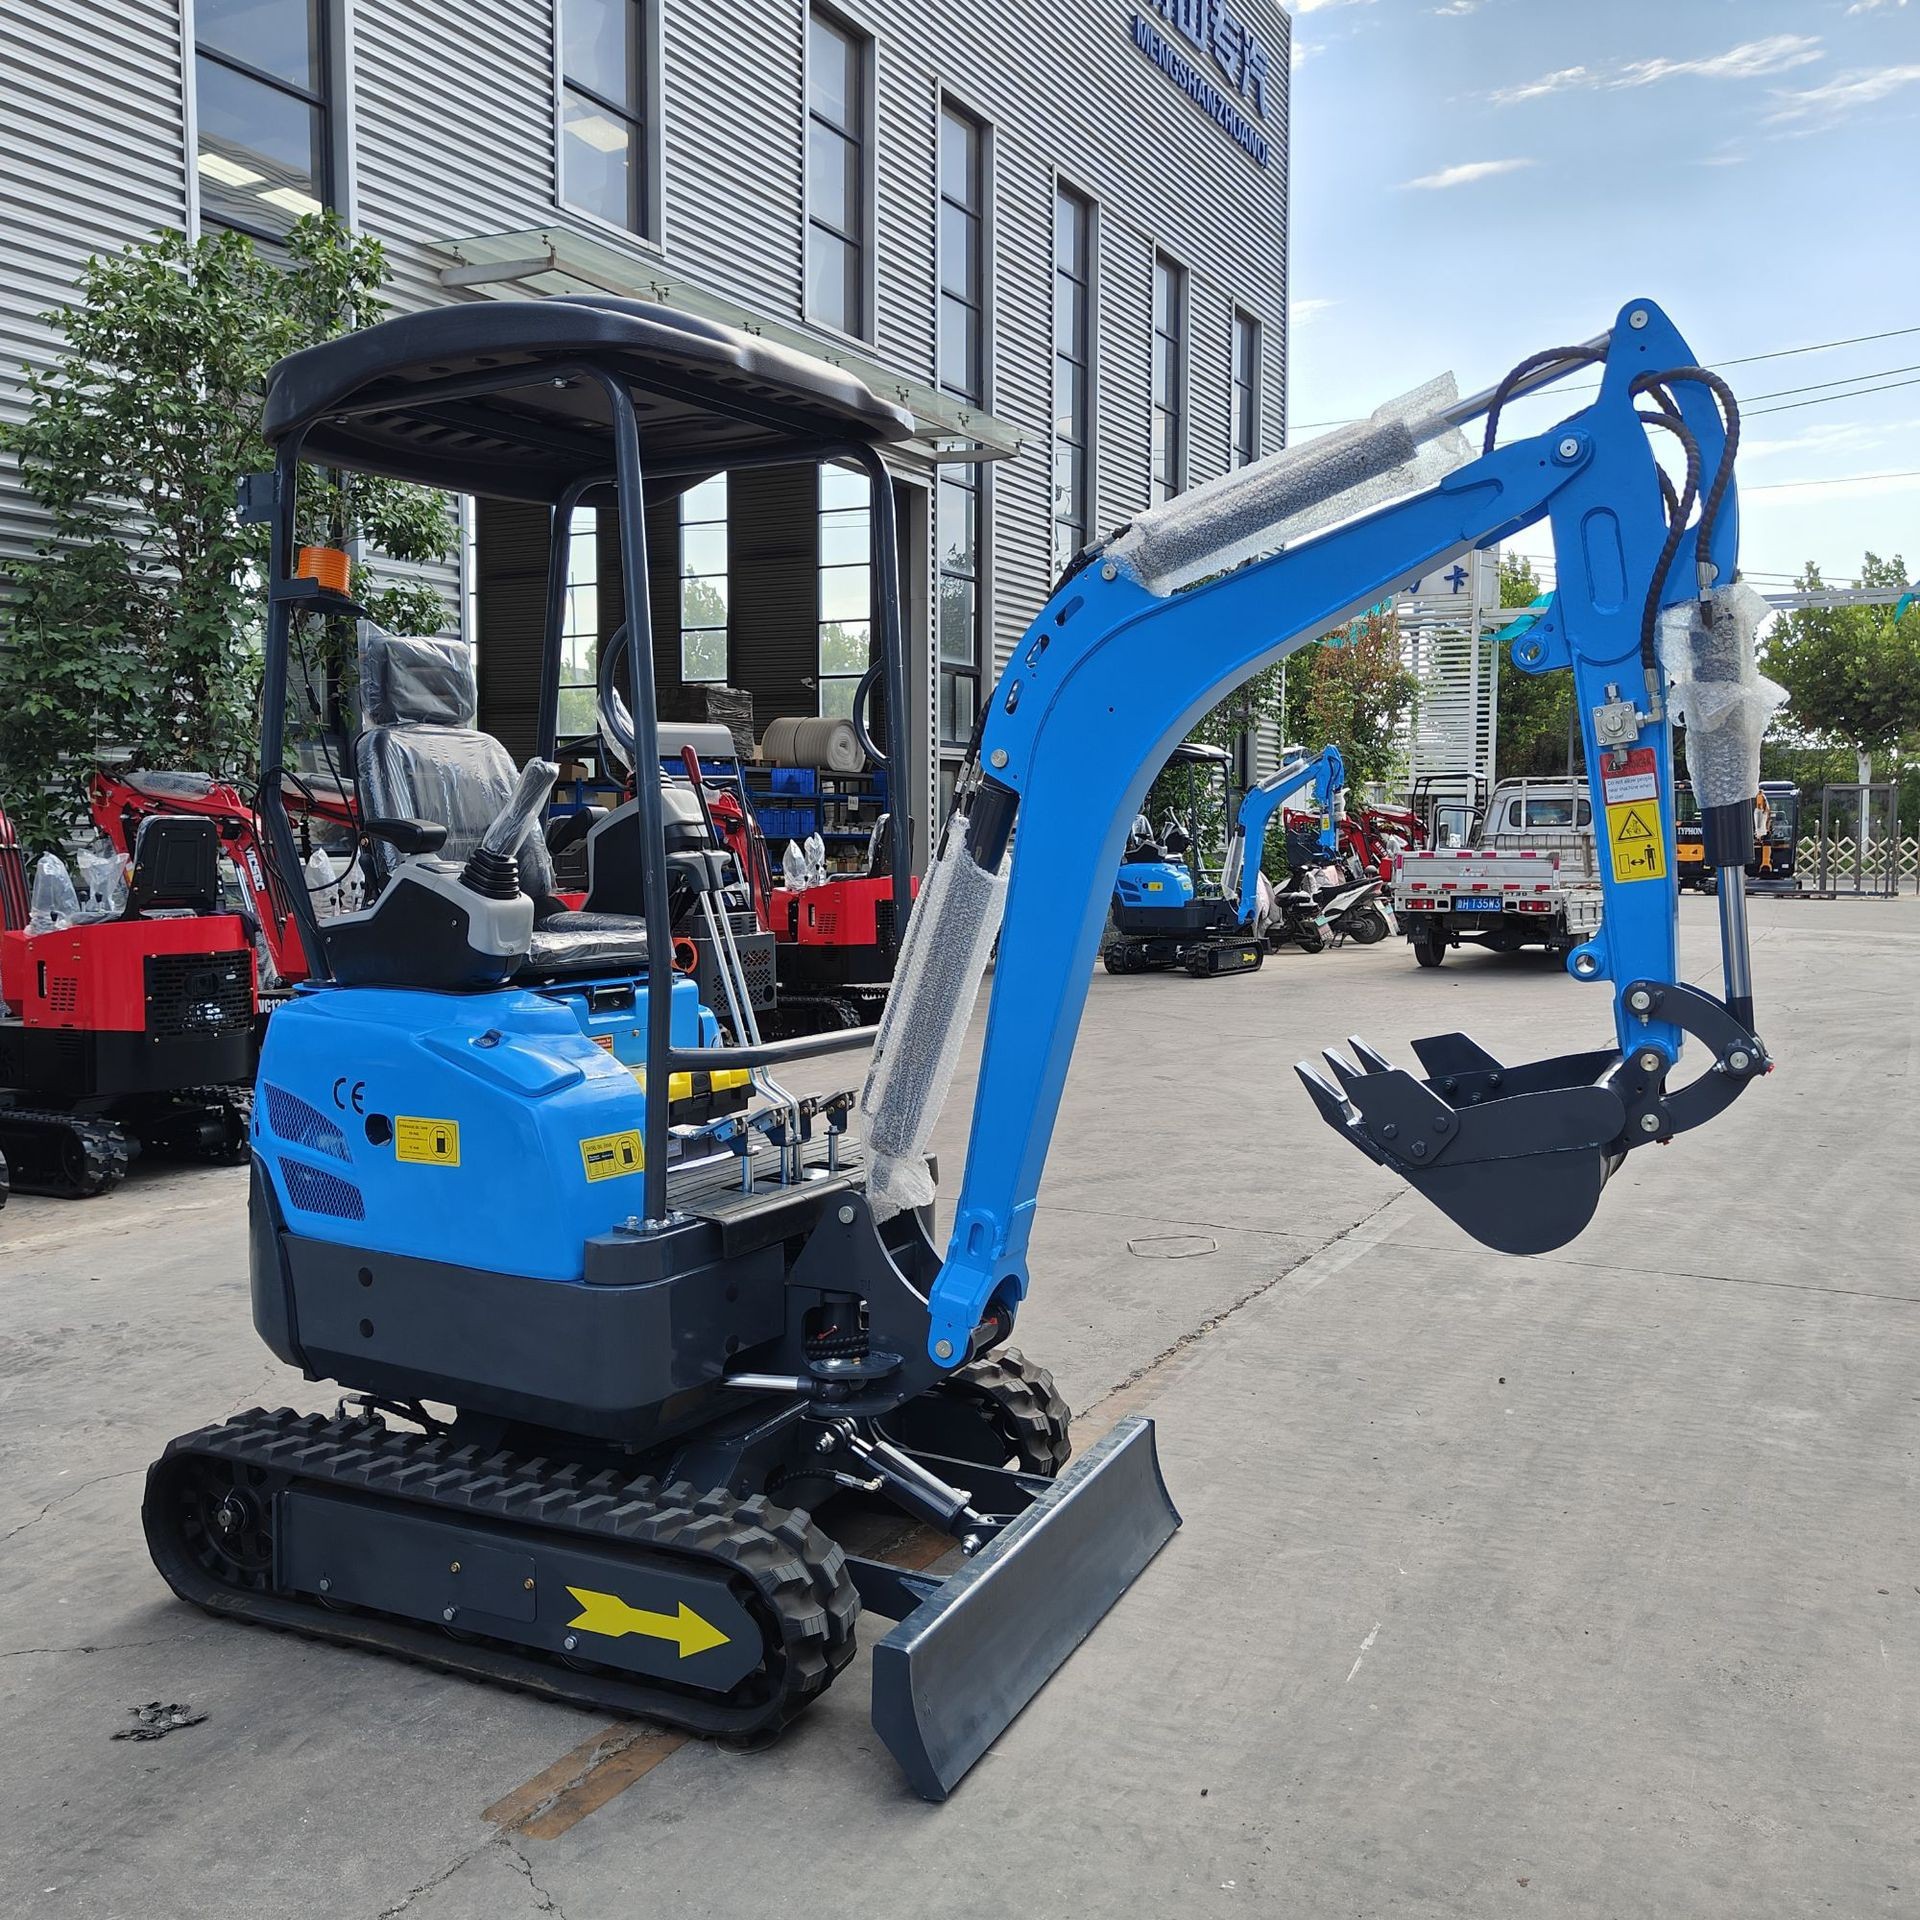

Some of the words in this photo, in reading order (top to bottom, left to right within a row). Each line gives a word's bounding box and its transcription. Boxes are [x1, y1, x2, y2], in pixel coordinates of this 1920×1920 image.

[1150, 0, 1269, 119] 山专汽
[245, 846, 266, 892] VICSEC
[333, 1077, 366, 1115] CE
